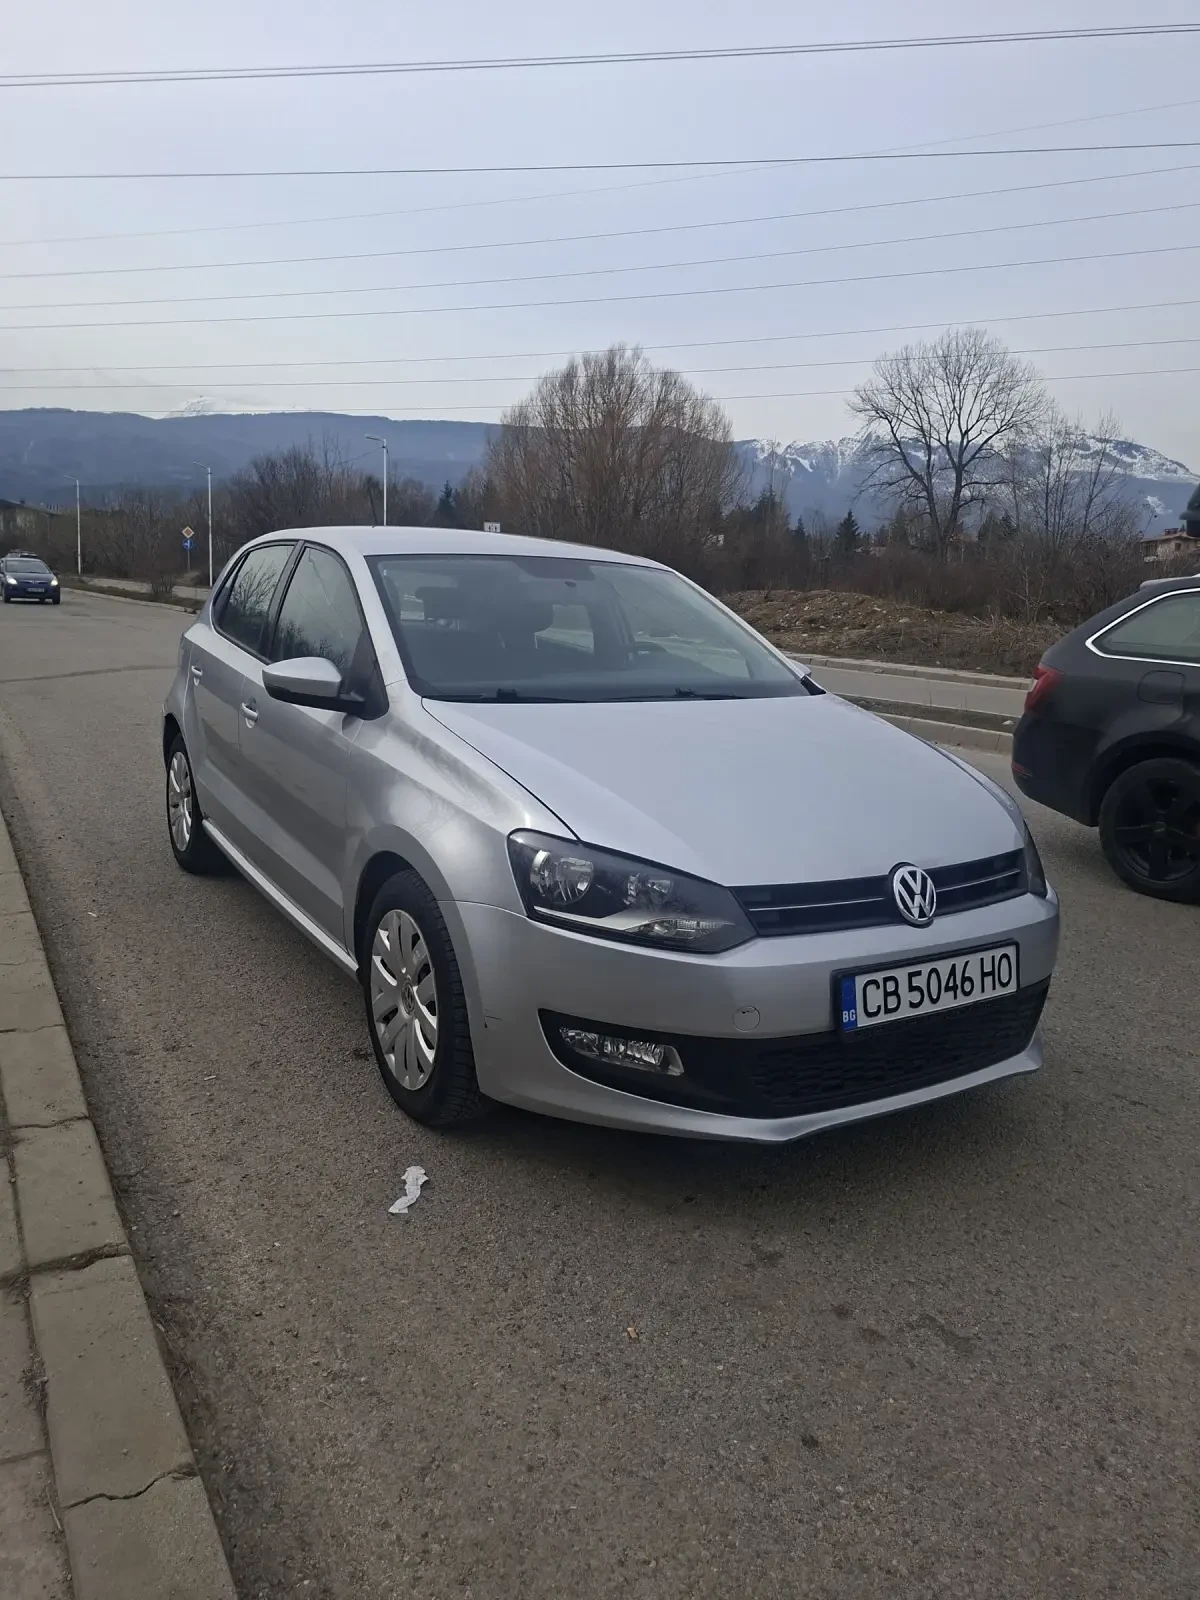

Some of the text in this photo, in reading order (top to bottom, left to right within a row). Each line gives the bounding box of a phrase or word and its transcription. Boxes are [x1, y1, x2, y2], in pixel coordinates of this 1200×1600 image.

[862, 953, 1013, 1018] CB 5046 HO
[842, 1010, 856, 1022] BG
